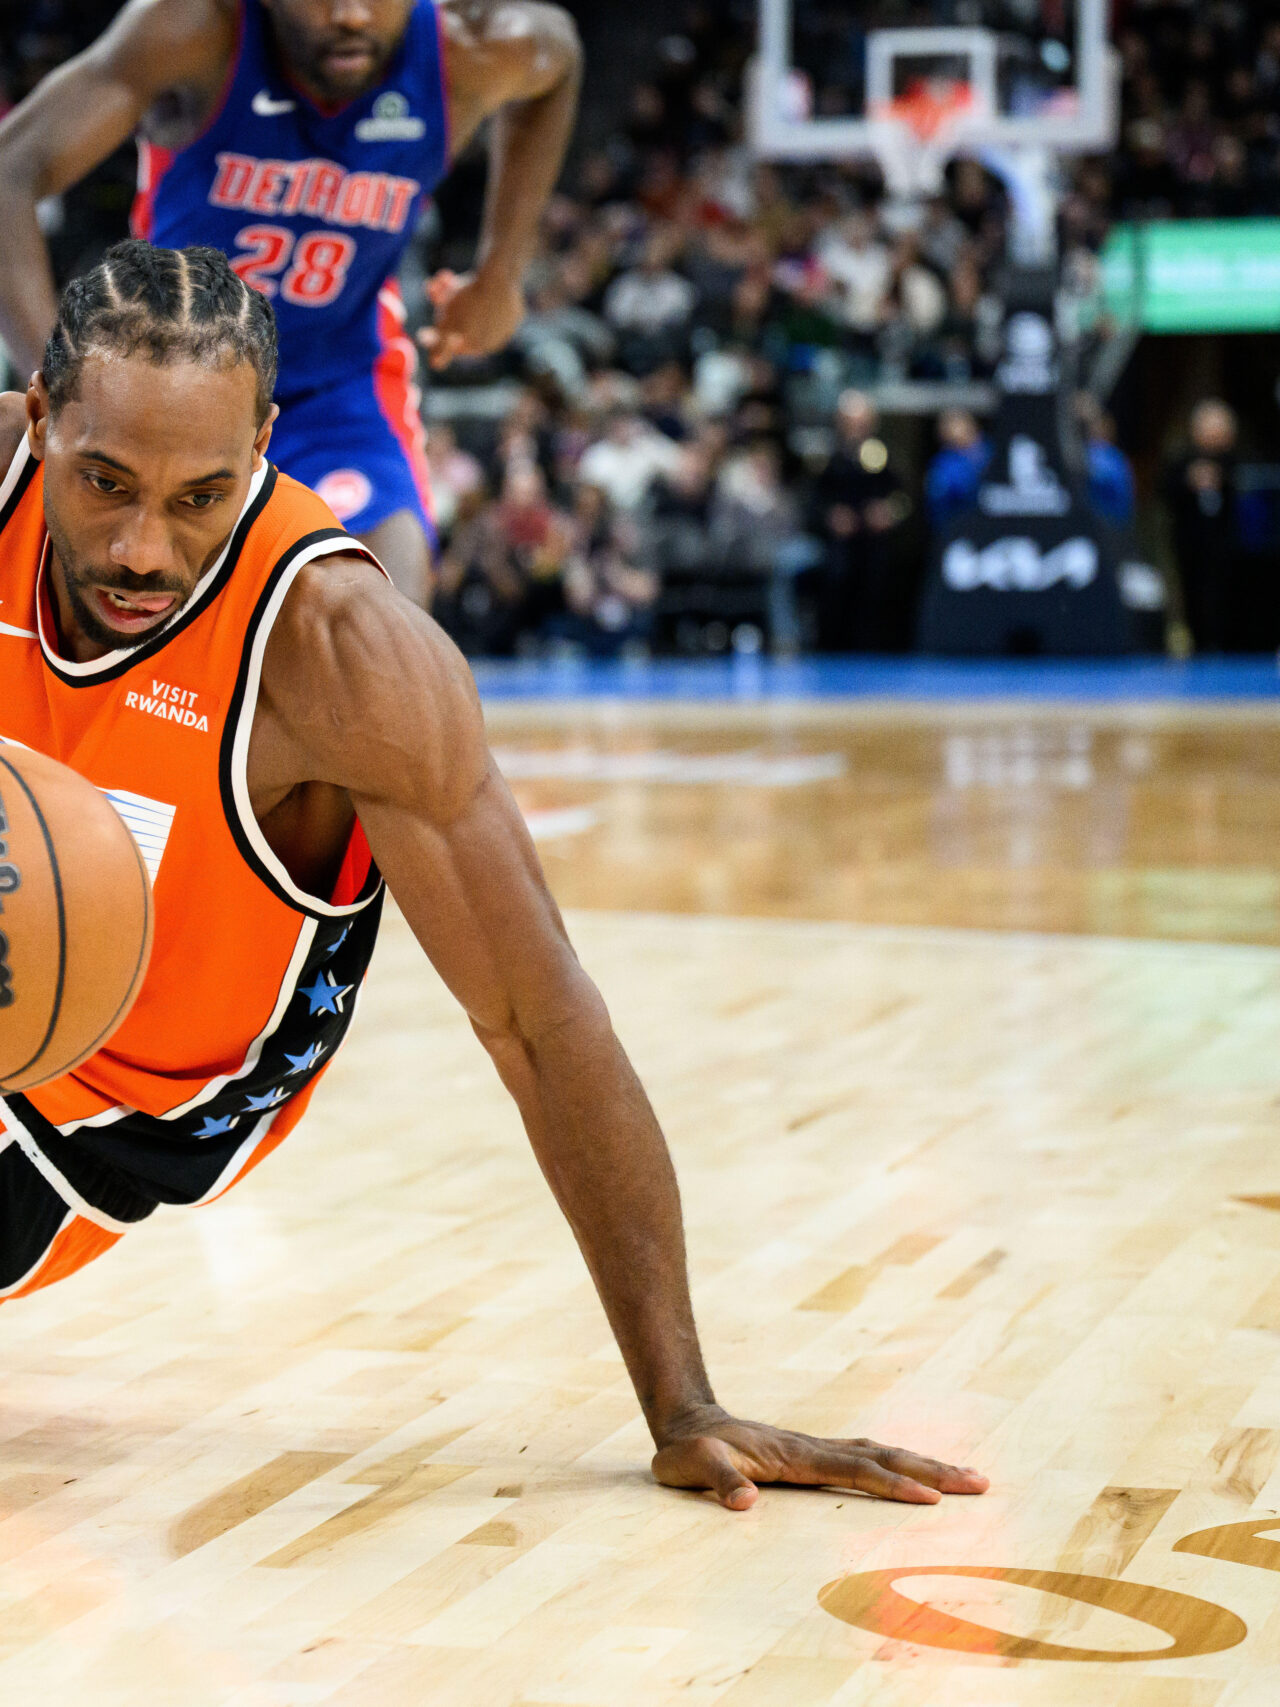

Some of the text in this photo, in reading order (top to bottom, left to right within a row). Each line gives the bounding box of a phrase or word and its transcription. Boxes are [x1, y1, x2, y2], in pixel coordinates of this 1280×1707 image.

[208, 151, 420, 234] DETROIT
[228, 222, 357, 309] 28
[125, 691, 208, 733] RWANDA
[152, 679, 198, 708] VISIT
